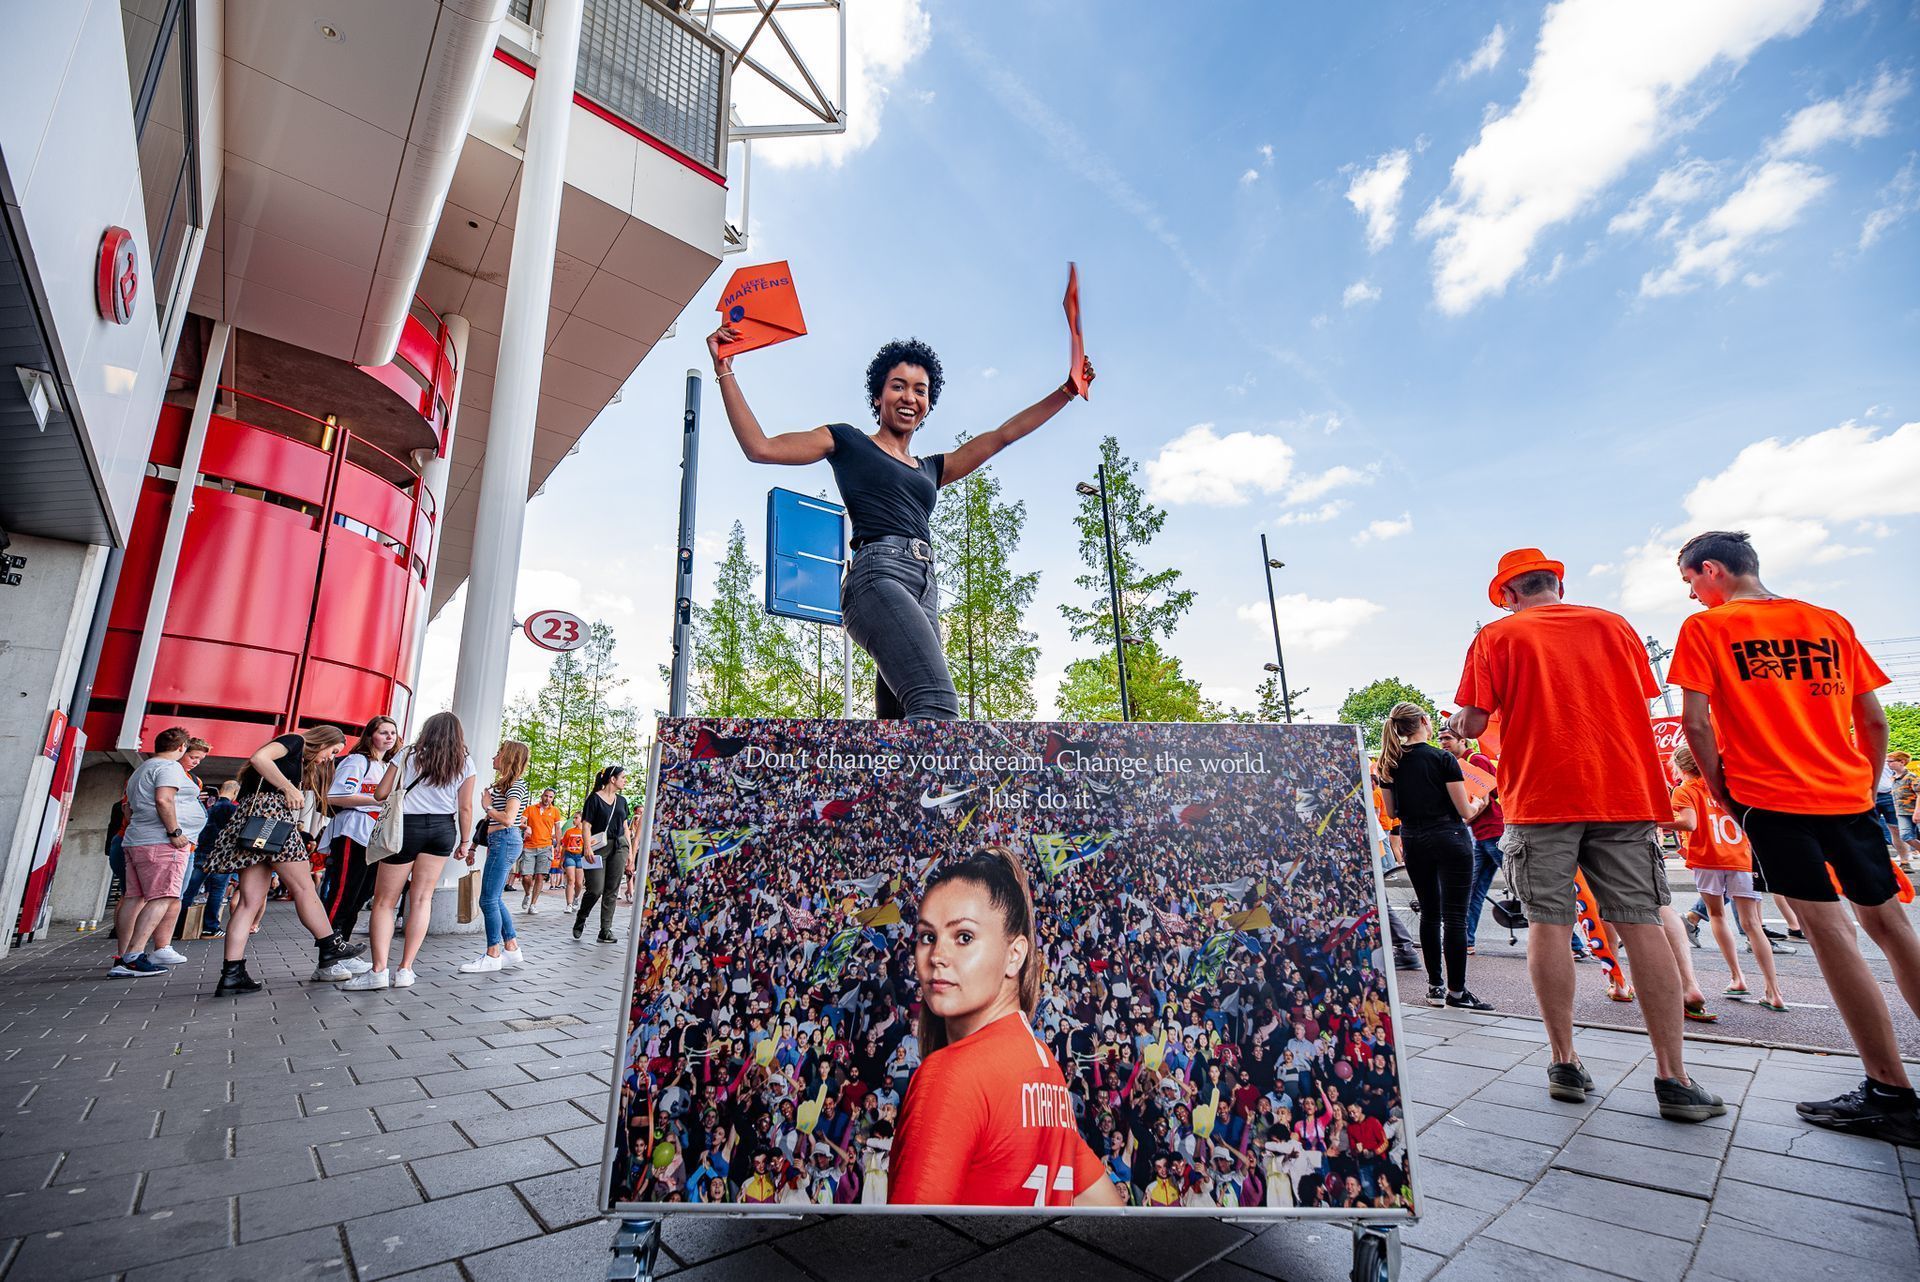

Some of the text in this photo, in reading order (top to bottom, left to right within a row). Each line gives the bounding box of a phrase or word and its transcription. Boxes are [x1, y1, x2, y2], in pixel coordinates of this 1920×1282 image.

[724, 278, 789, 307] MARTENS
[543, 618, 579, 642] 23
[745, 746, 1271, 779] Don't change your dream. Change the world.
[986, 786, 1097, 812] Just do it.
[1708, 813, 1743, 845] 10
[1021, 1164, 1074, 1208] 11
